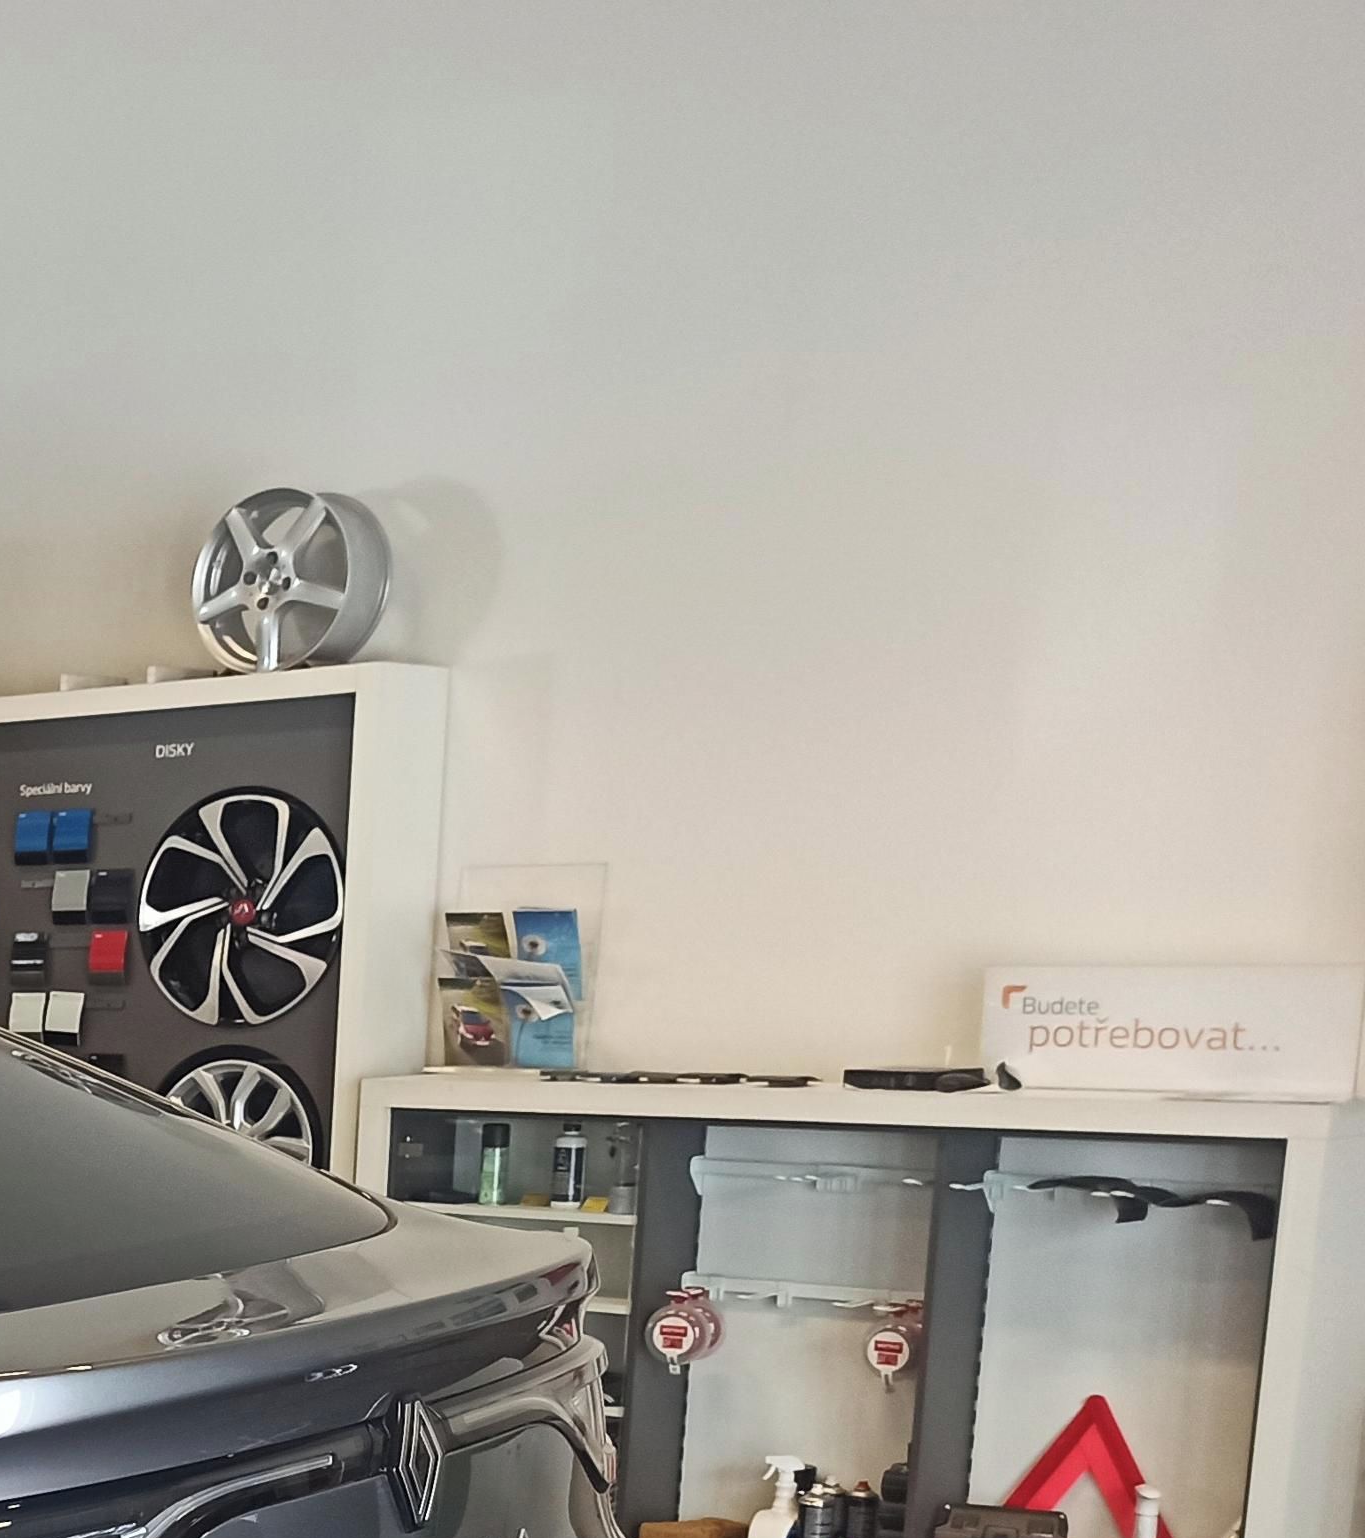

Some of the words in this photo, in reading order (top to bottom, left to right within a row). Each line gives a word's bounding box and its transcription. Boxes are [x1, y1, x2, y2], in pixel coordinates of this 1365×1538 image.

[155, 742, 195, 759] DISKY
[64, 782, 93, 795] barvy
[1022, 997, 1100, 1015] Budete
[1028, 1017, 1280, 1054] potřebovat...
